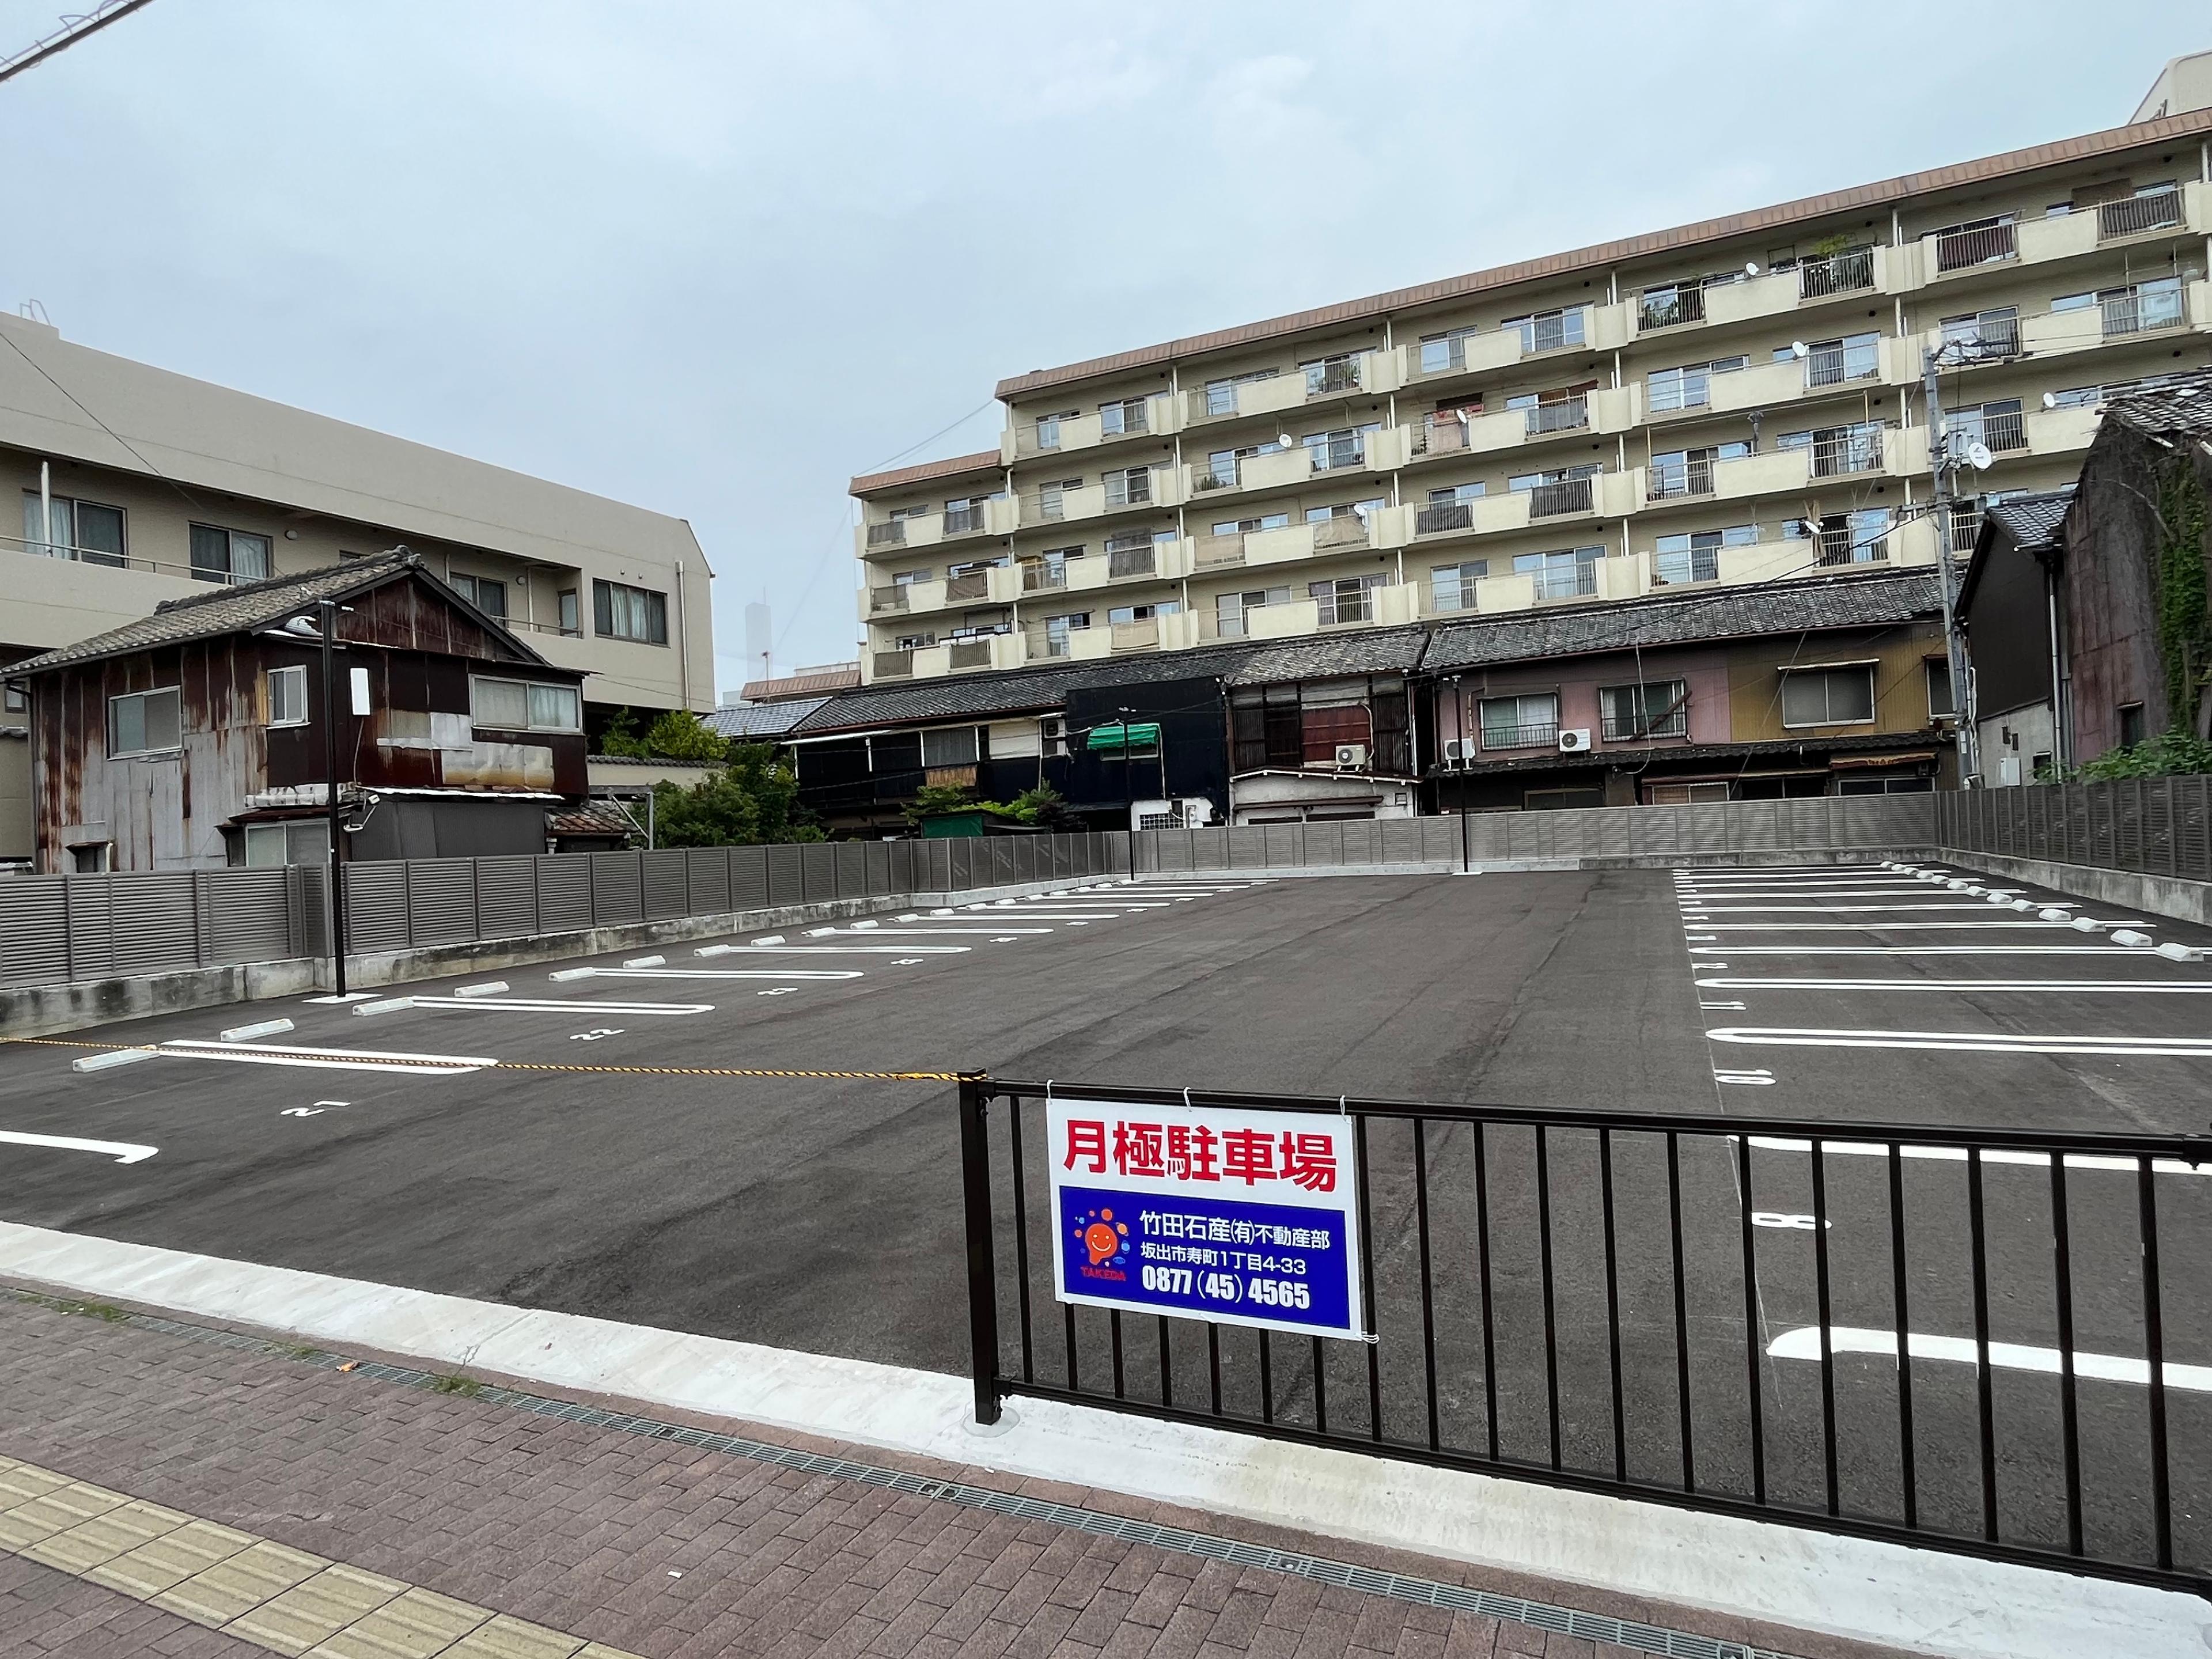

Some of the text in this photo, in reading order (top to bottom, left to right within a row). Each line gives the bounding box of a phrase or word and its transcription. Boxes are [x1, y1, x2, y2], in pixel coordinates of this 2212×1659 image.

[570, 1028, 625, 1040] 22
[1714, 1069, 1777, 1085] 10
[280, 1100, 351, 1117] 21
[1063, 1119, 1337, 1192] 月極駐車場
[1139, 1210, 1330, 1250] 竹田石産(有)不動産部
[1140, 1242, 1306, 1275] 坂出市寿町1丁目4-33
